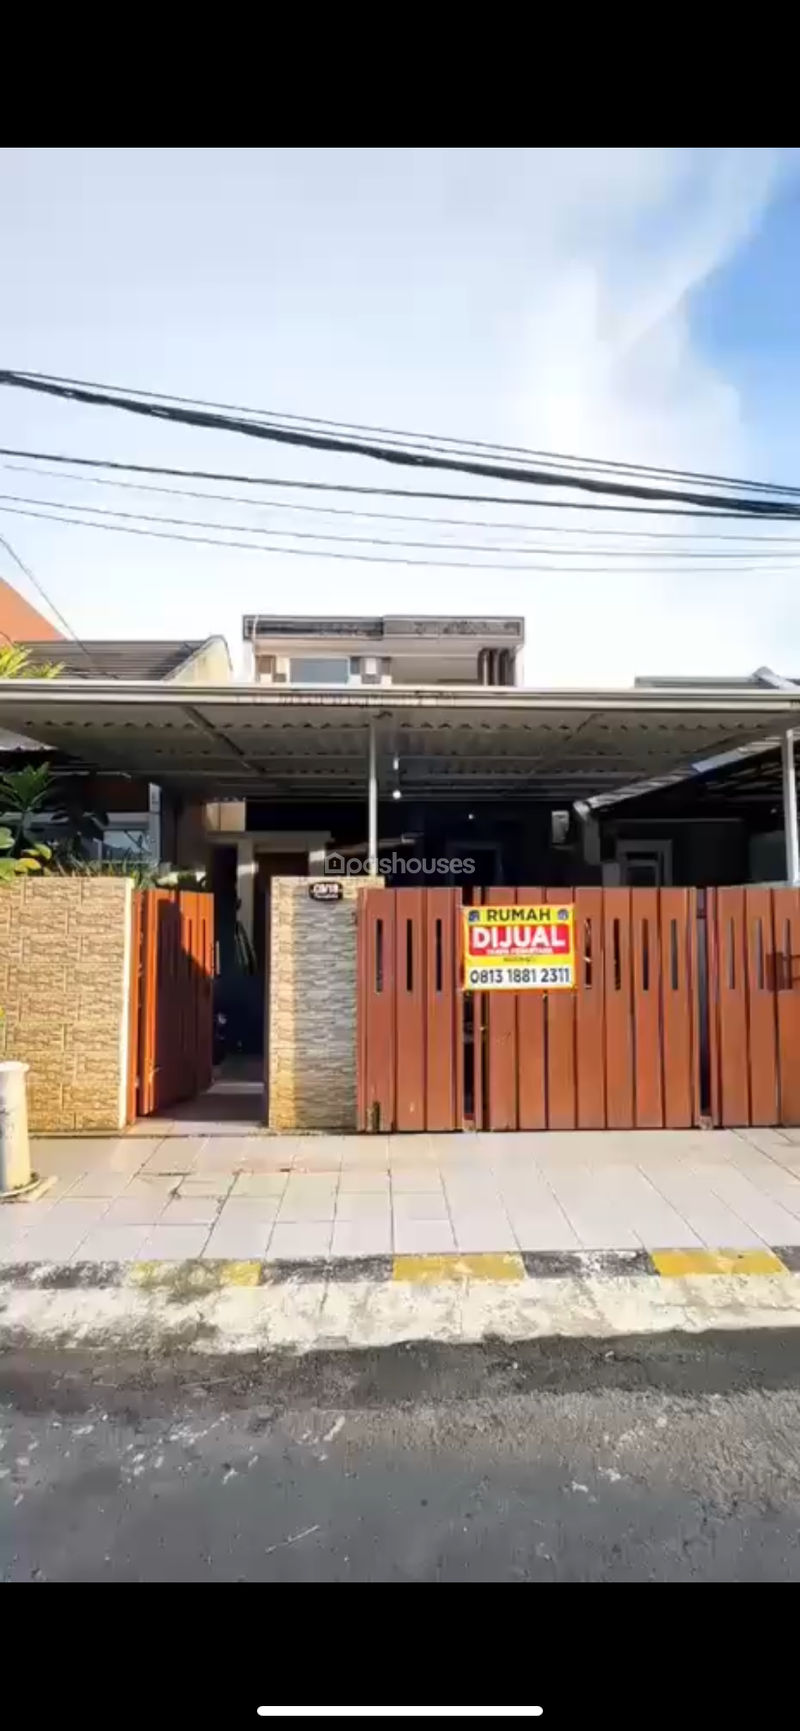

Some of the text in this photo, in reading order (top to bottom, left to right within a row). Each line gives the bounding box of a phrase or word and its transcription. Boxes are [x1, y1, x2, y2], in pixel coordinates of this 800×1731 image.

[486, 908, 551, 921] RUMAH
[472, 926, 566, 949] DIJUAL
[469, 968, 570, 984] 0813 1881 2311
